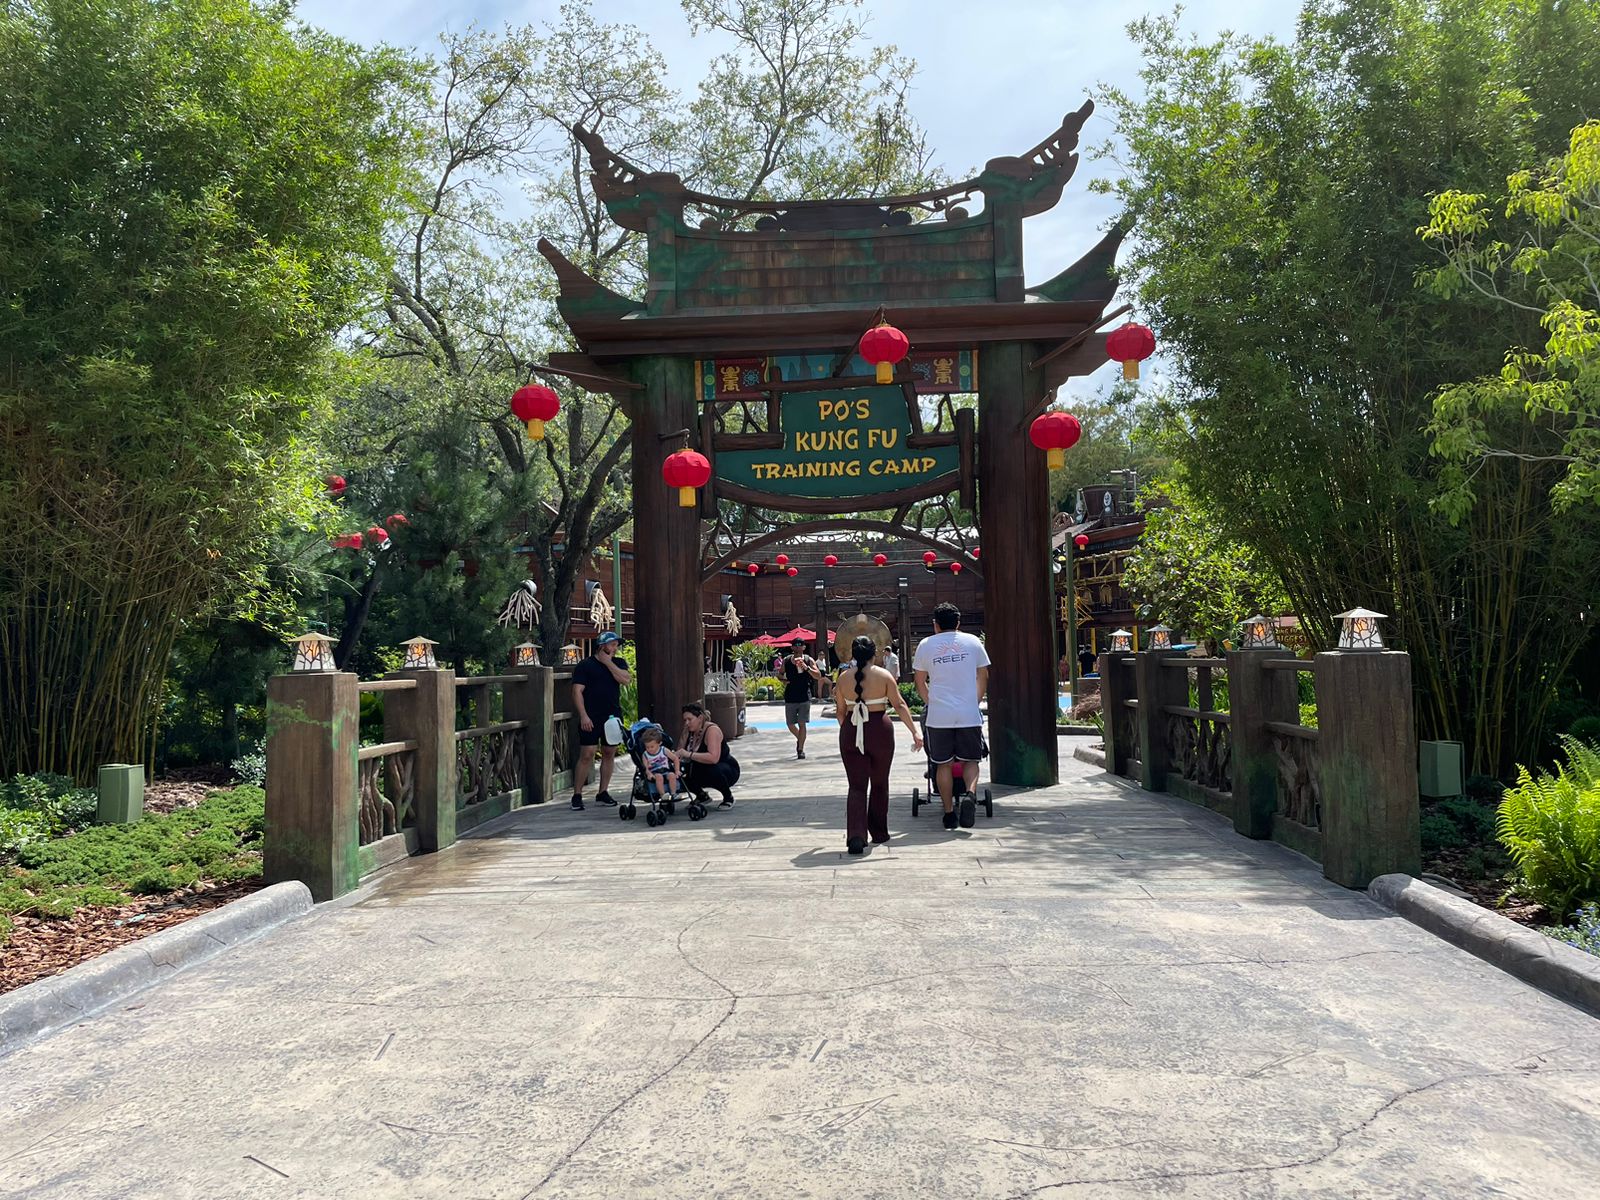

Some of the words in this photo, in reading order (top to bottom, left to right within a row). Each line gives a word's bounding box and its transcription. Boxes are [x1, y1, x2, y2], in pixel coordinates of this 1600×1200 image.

[818, 399, 870, 421] PO'S
[796, 429, 859, 451] KUNG
[867, 428, 897, 449] FU
[751, 461, 861, 479] TRAINING
[867, 457, 937, 475] CAMP
[933, 653, 968, 664] REEF
